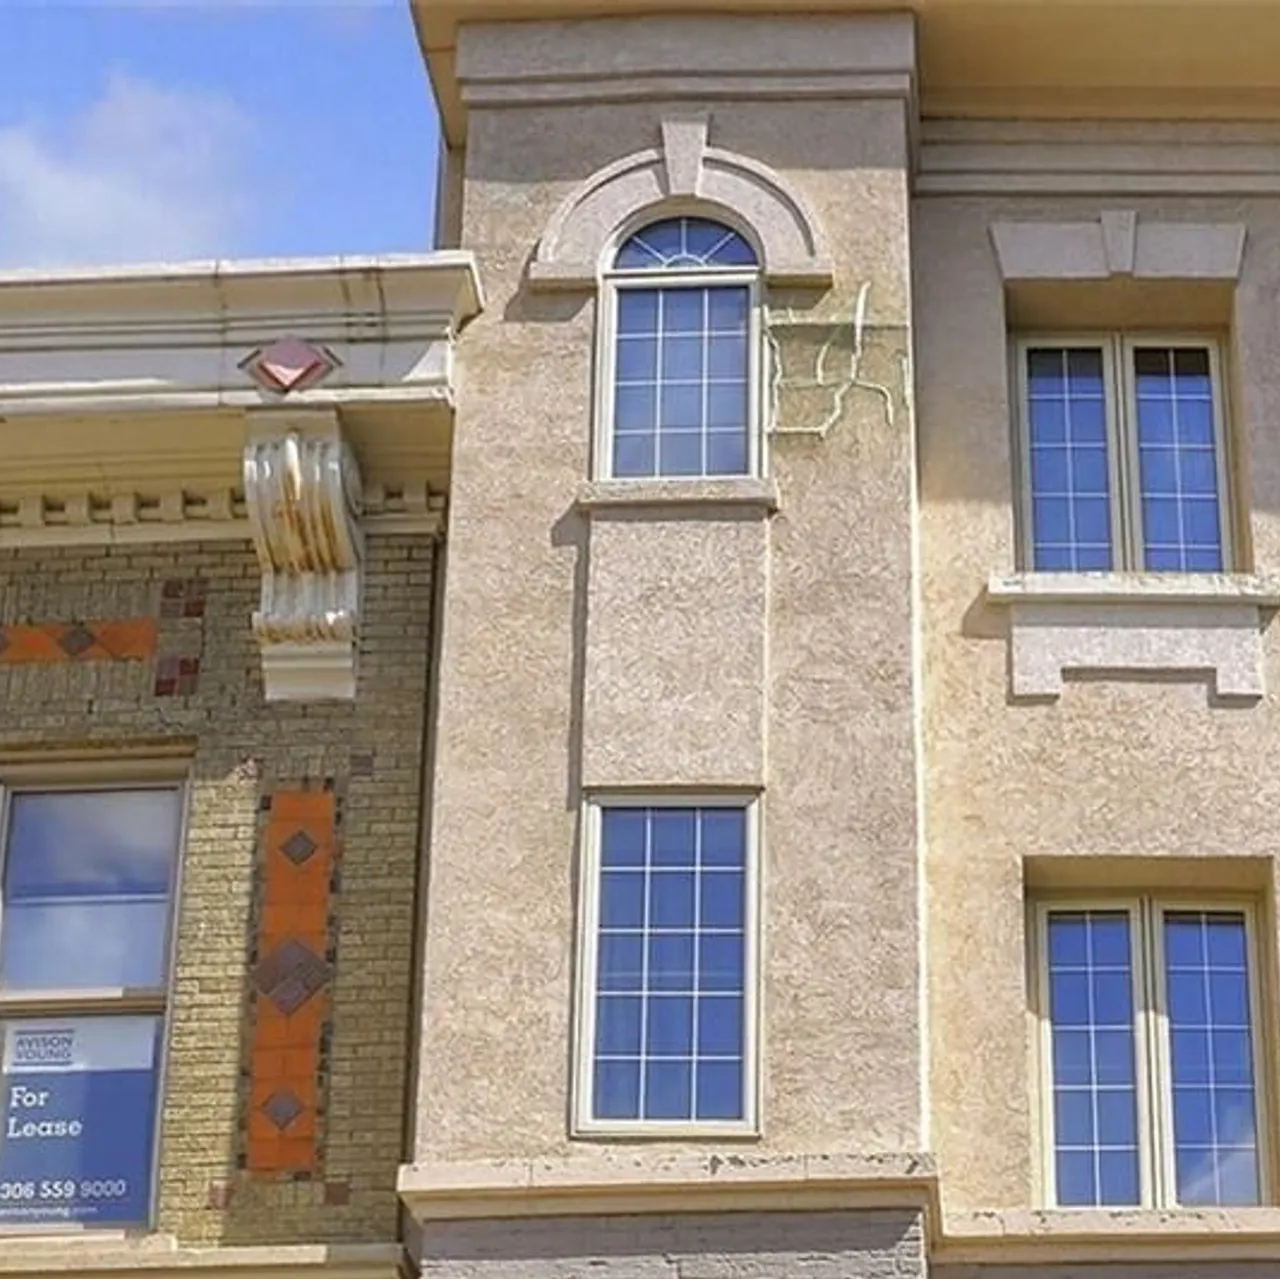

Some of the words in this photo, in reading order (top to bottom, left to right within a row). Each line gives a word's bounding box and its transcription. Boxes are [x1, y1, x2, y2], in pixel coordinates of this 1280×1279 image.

[10, 1086, 50, 1108] For
[7, 1117, 83, 1138] Lease
[0, 1181, 35, 1199] 306
[39, 1181, 76, 1198] 559
